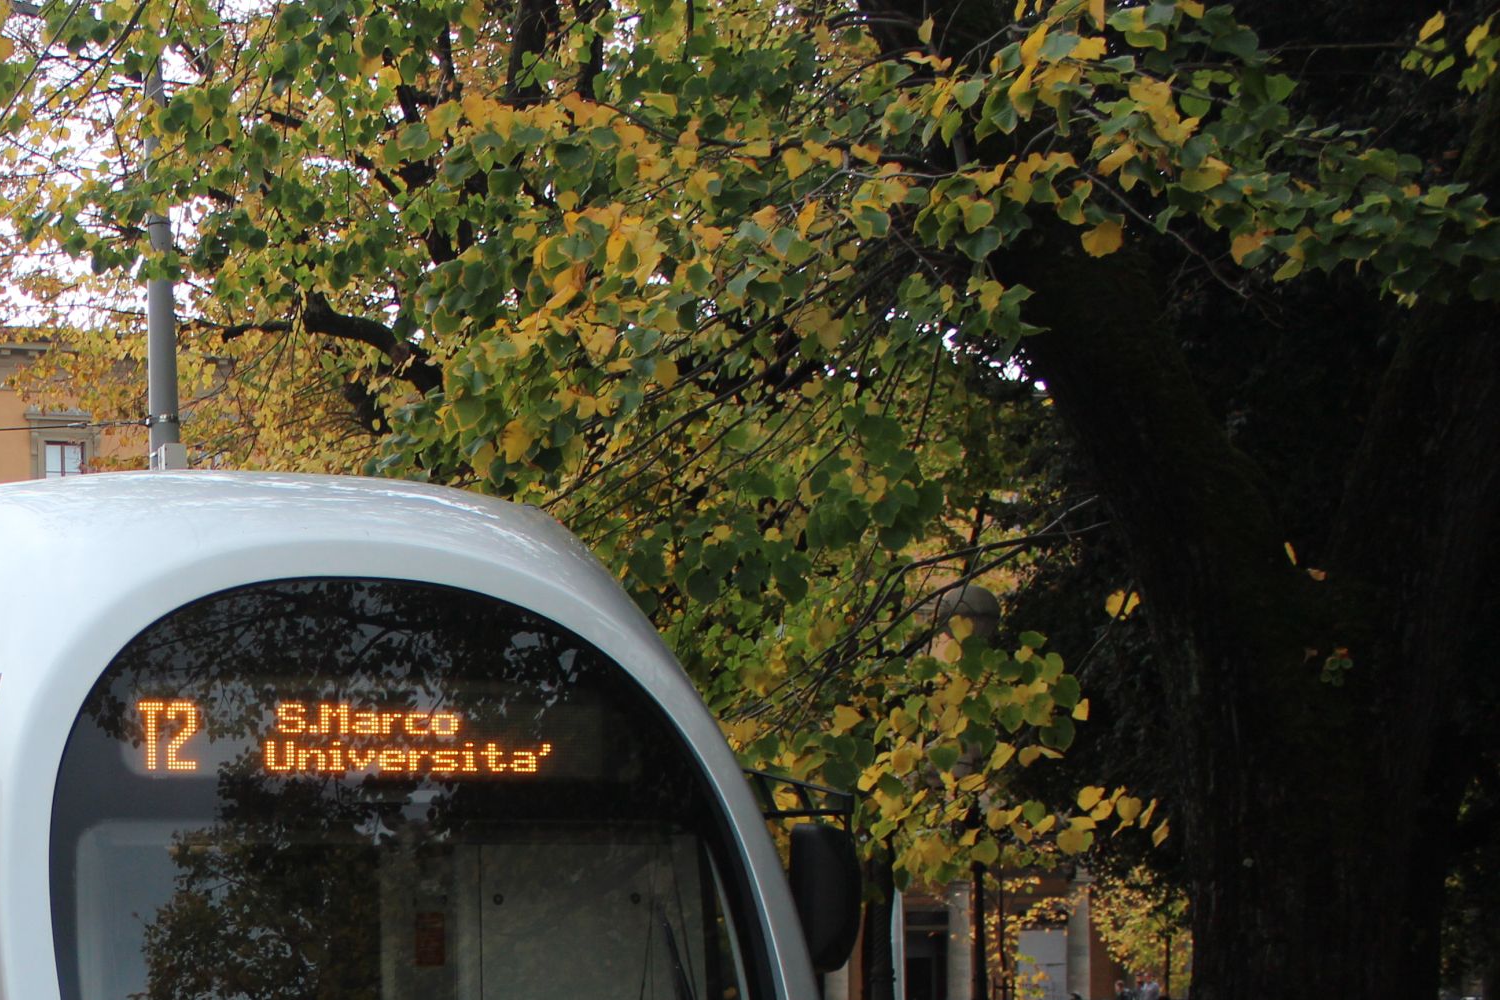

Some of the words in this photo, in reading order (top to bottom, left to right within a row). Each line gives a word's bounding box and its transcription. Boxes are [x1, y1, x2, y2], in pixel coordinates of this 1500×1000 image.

[137, 700, 199, 771] T2
[276, 702, 460, 737] S.Marco
[264, 740, 552, 774] Universita'
